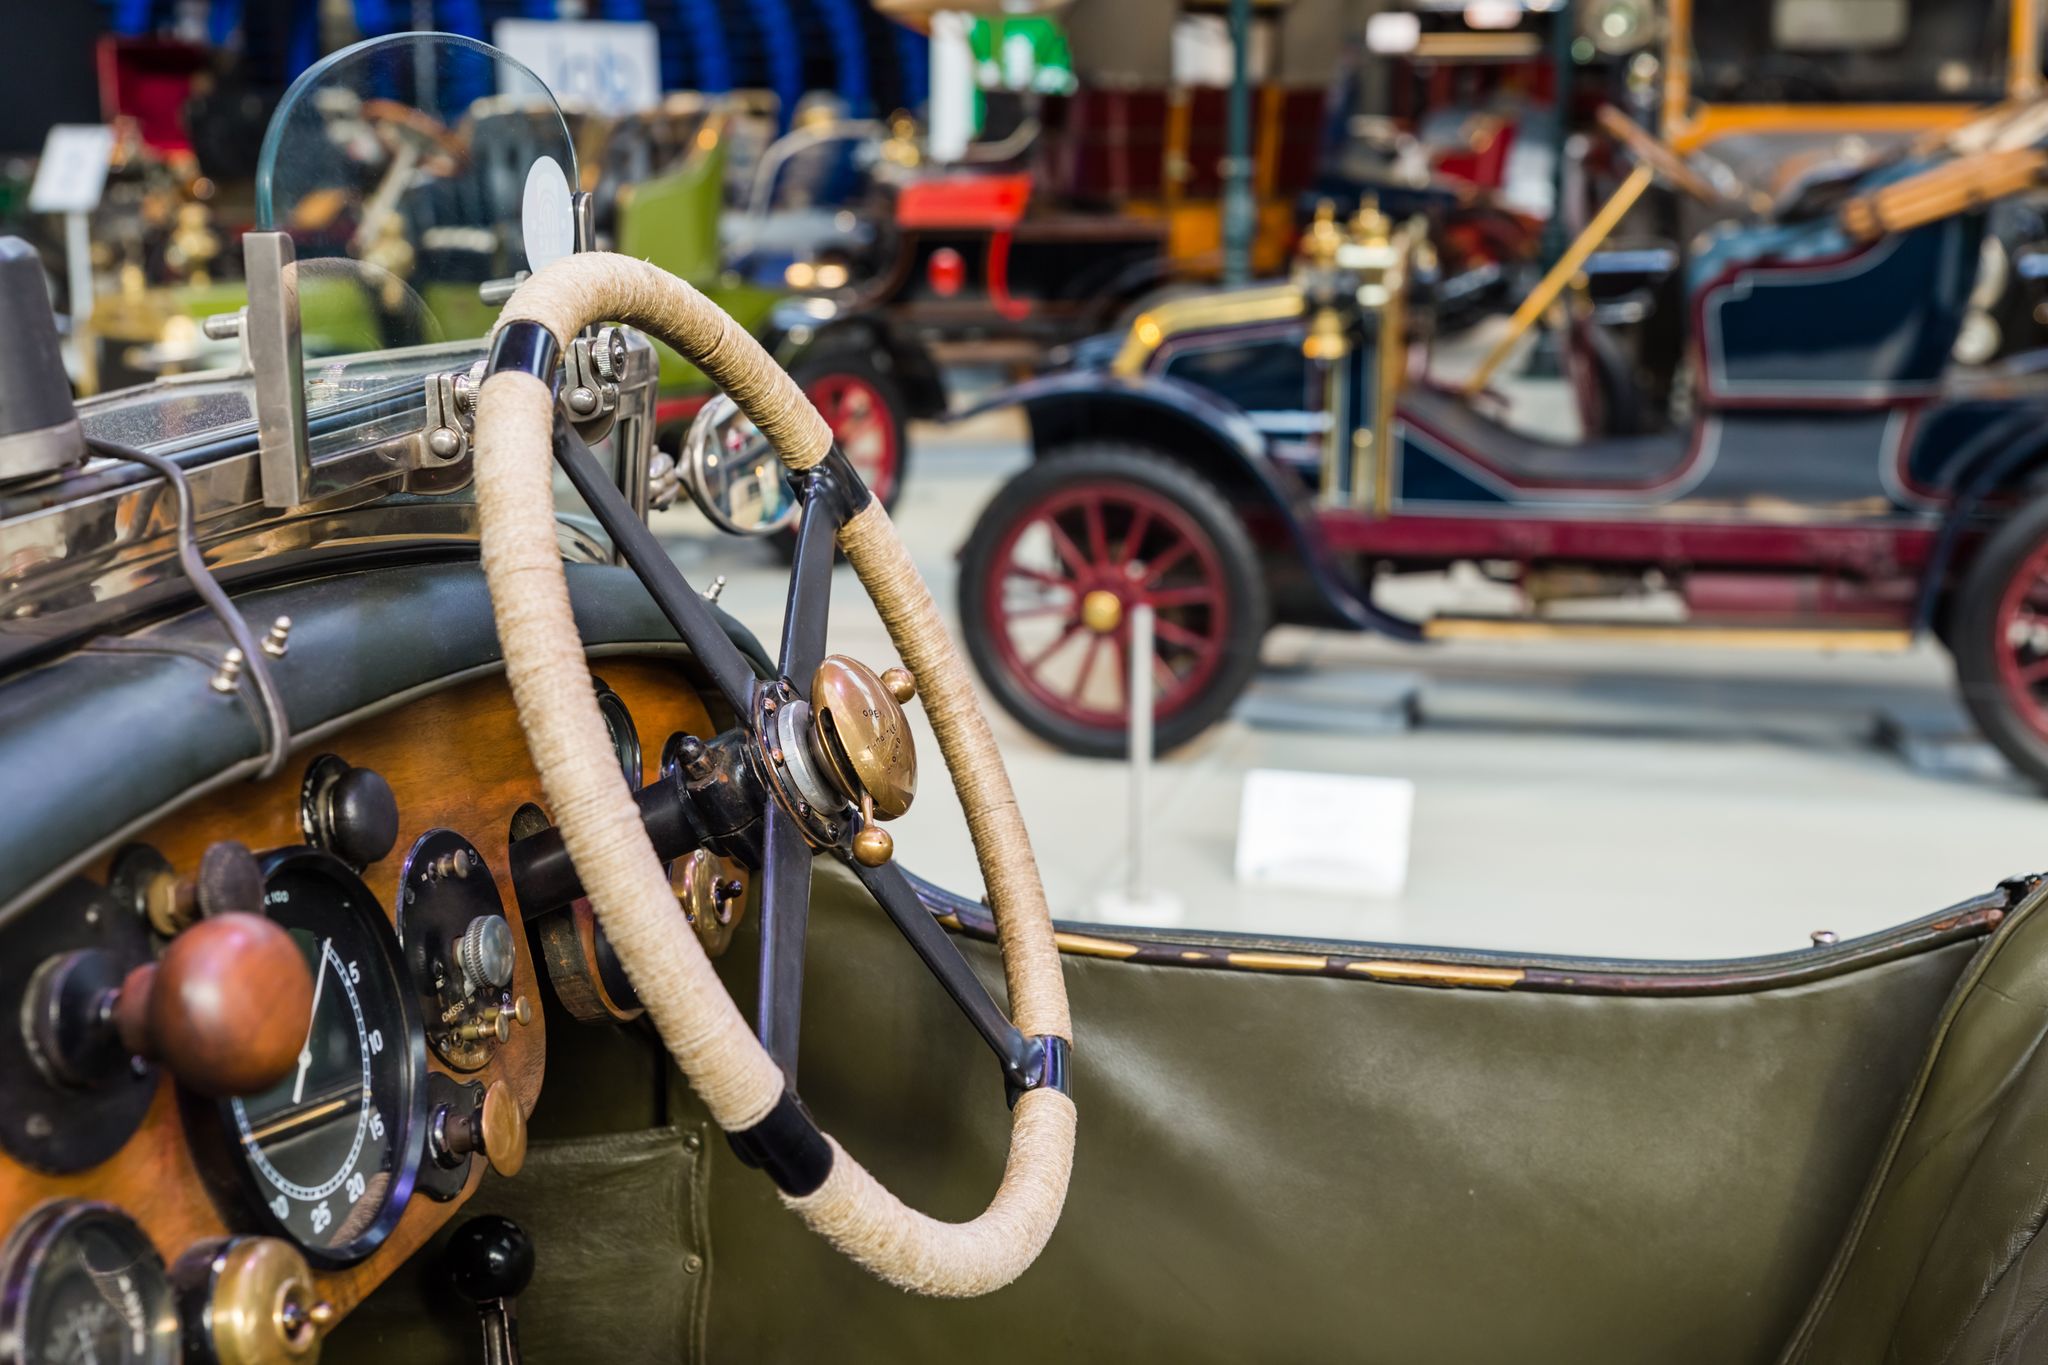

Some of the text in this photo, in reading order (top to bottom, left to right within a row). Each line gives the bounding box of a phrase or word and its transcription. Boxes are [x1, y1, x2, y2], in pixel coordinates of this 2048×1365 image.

[348, 960, 360, 984] 5
[368, 1029, 383, 1055] 10
[368, 1112, 385, 1141] 15
[346, 1172, 366, 1204] 20
[310, 1200, 332, 1235] 25
